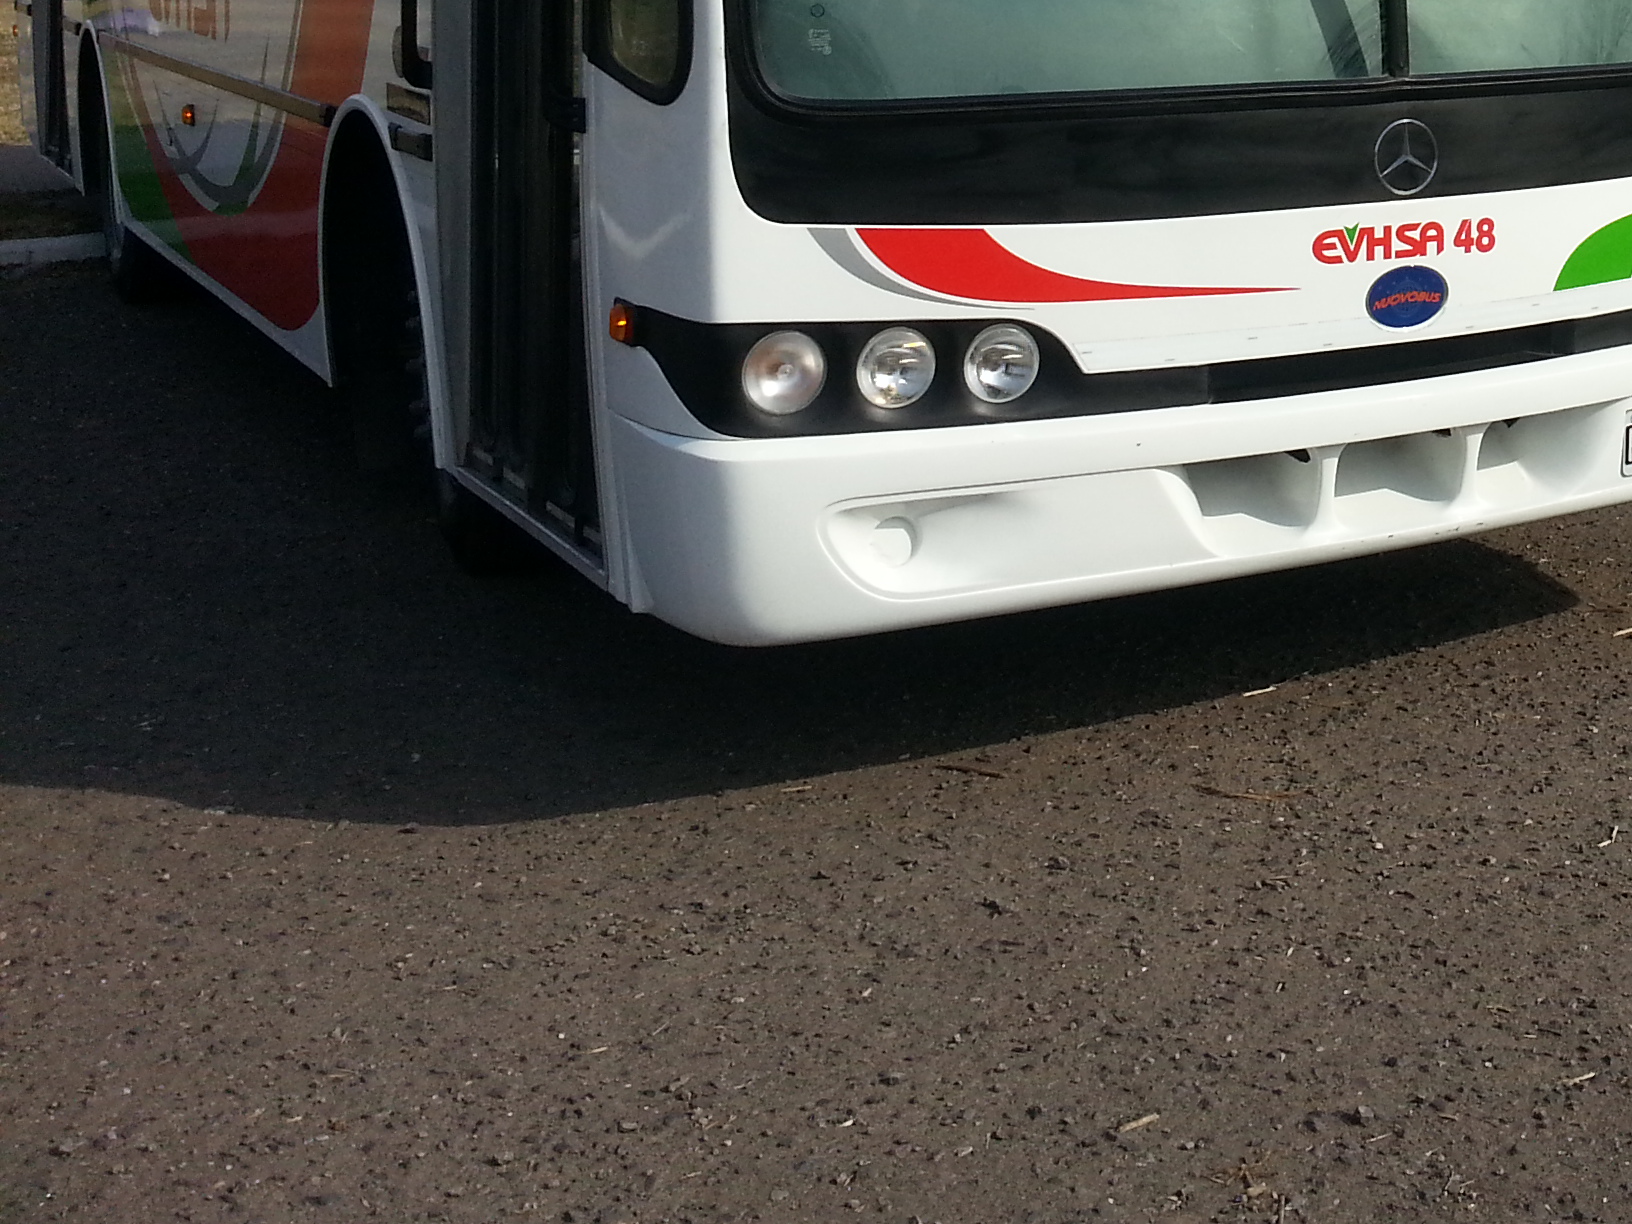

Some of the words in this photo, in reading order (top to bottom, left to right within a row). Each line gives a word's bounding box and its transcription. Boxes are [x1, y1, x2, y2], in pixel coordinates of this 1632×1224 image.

[1312, 221, 1445, 264] EVHSA
[1453, 217, 1496, 254] 48
[1372, 290, 1441, 310] NUOVOBUS
